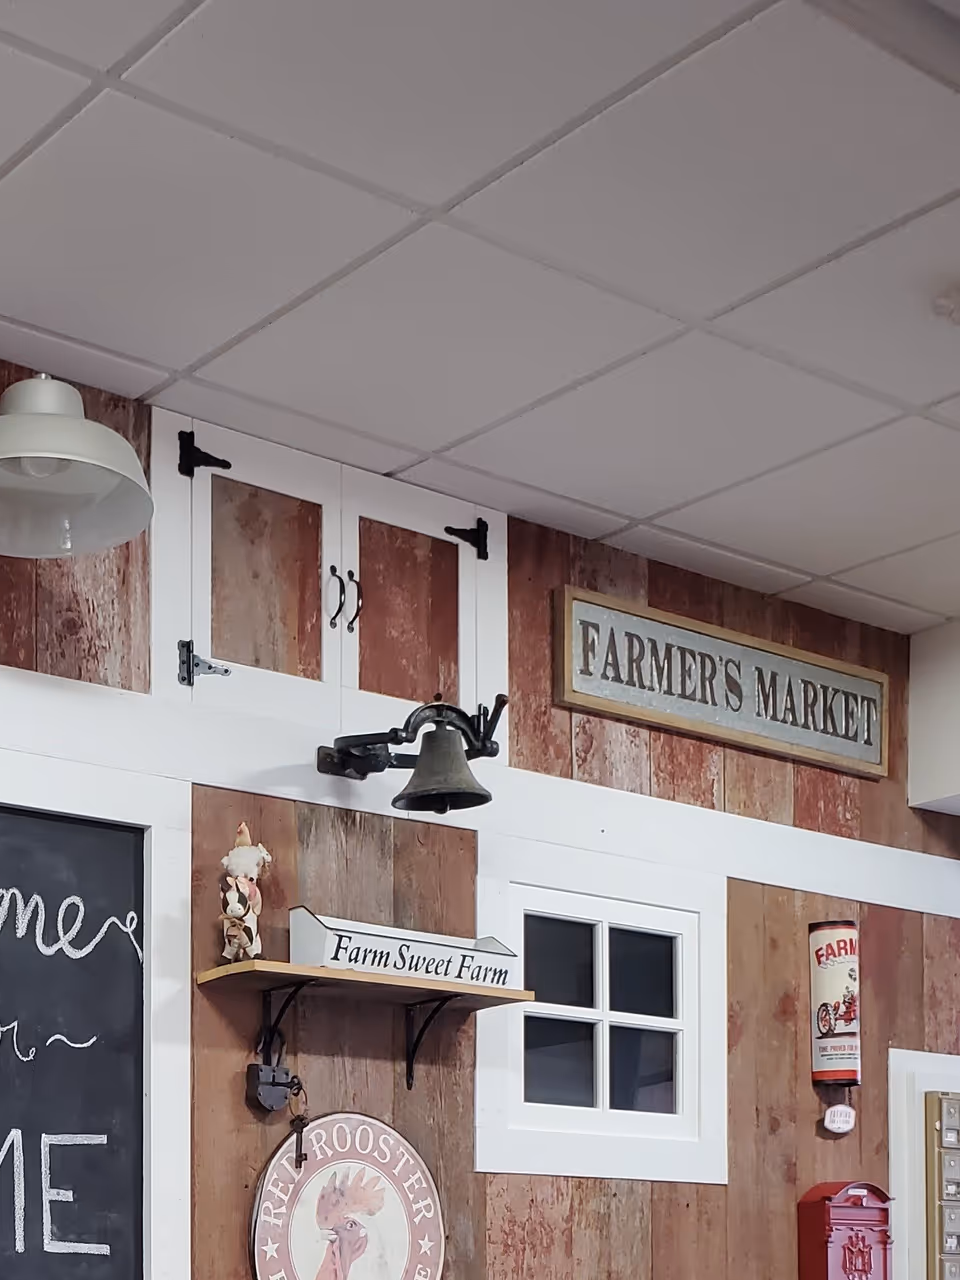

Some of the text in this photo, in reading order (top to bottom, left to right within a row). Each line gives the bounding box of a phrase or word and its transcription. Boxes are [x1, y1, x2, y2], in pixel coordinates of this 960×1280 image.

[577, 619, 878, 746] FARMER'S MARKET
[330, 933, 510, 987] Farm Sweet Farm
[260, 1123, 435, 1228] RED ROOSTER
